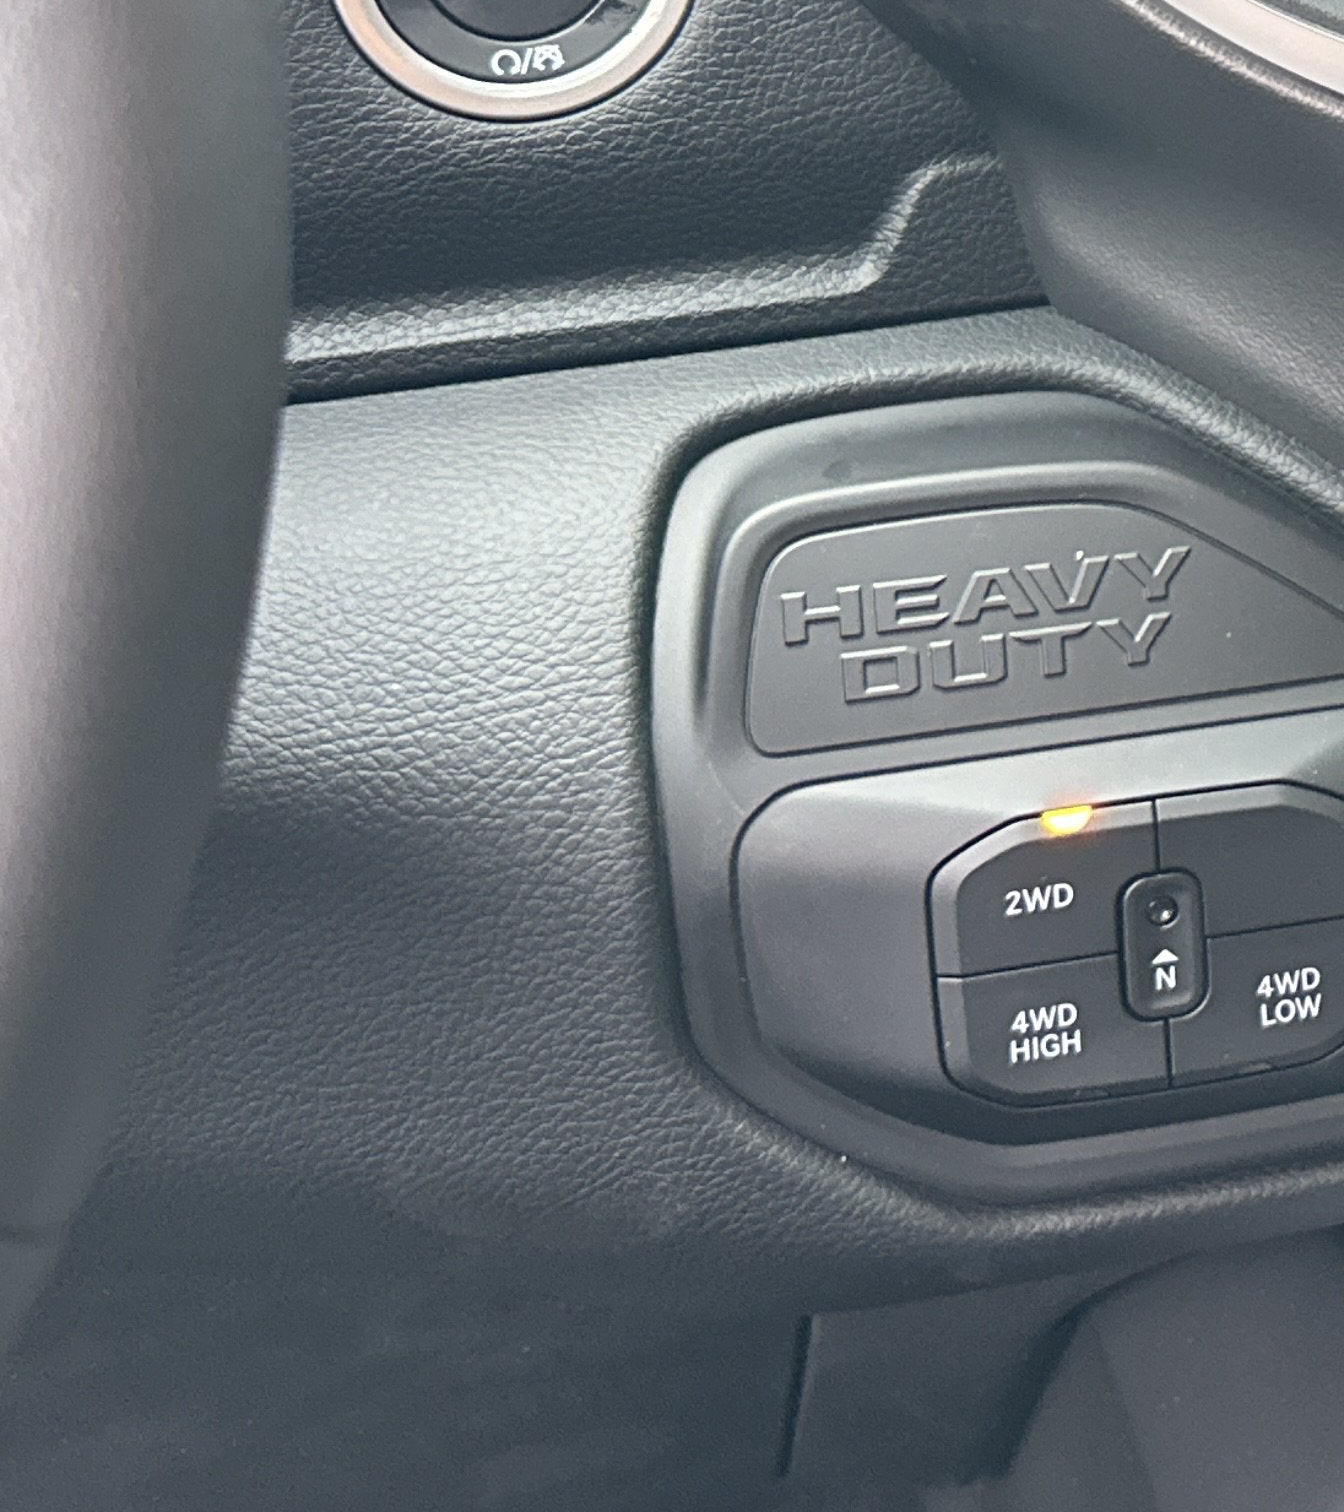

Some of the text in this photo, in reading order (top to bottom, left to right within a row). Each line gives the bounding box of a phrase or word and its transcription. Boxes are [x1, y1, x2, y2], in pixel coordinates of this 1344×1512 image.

[781, 546, 1190, 645] HEAVY
[841, 612, 1171, 704] DUTY
[1005, 883, 1074, 916] 2WD
[1155, 966, 1176, 990] N
[1256, 967, 1320, 998] 4WD
[1011, 1003, 1078, 1034] 4WD
[1260, 993, 1322, 1027] LOW
[1009, 1030, 1082, 1063] HIGH
